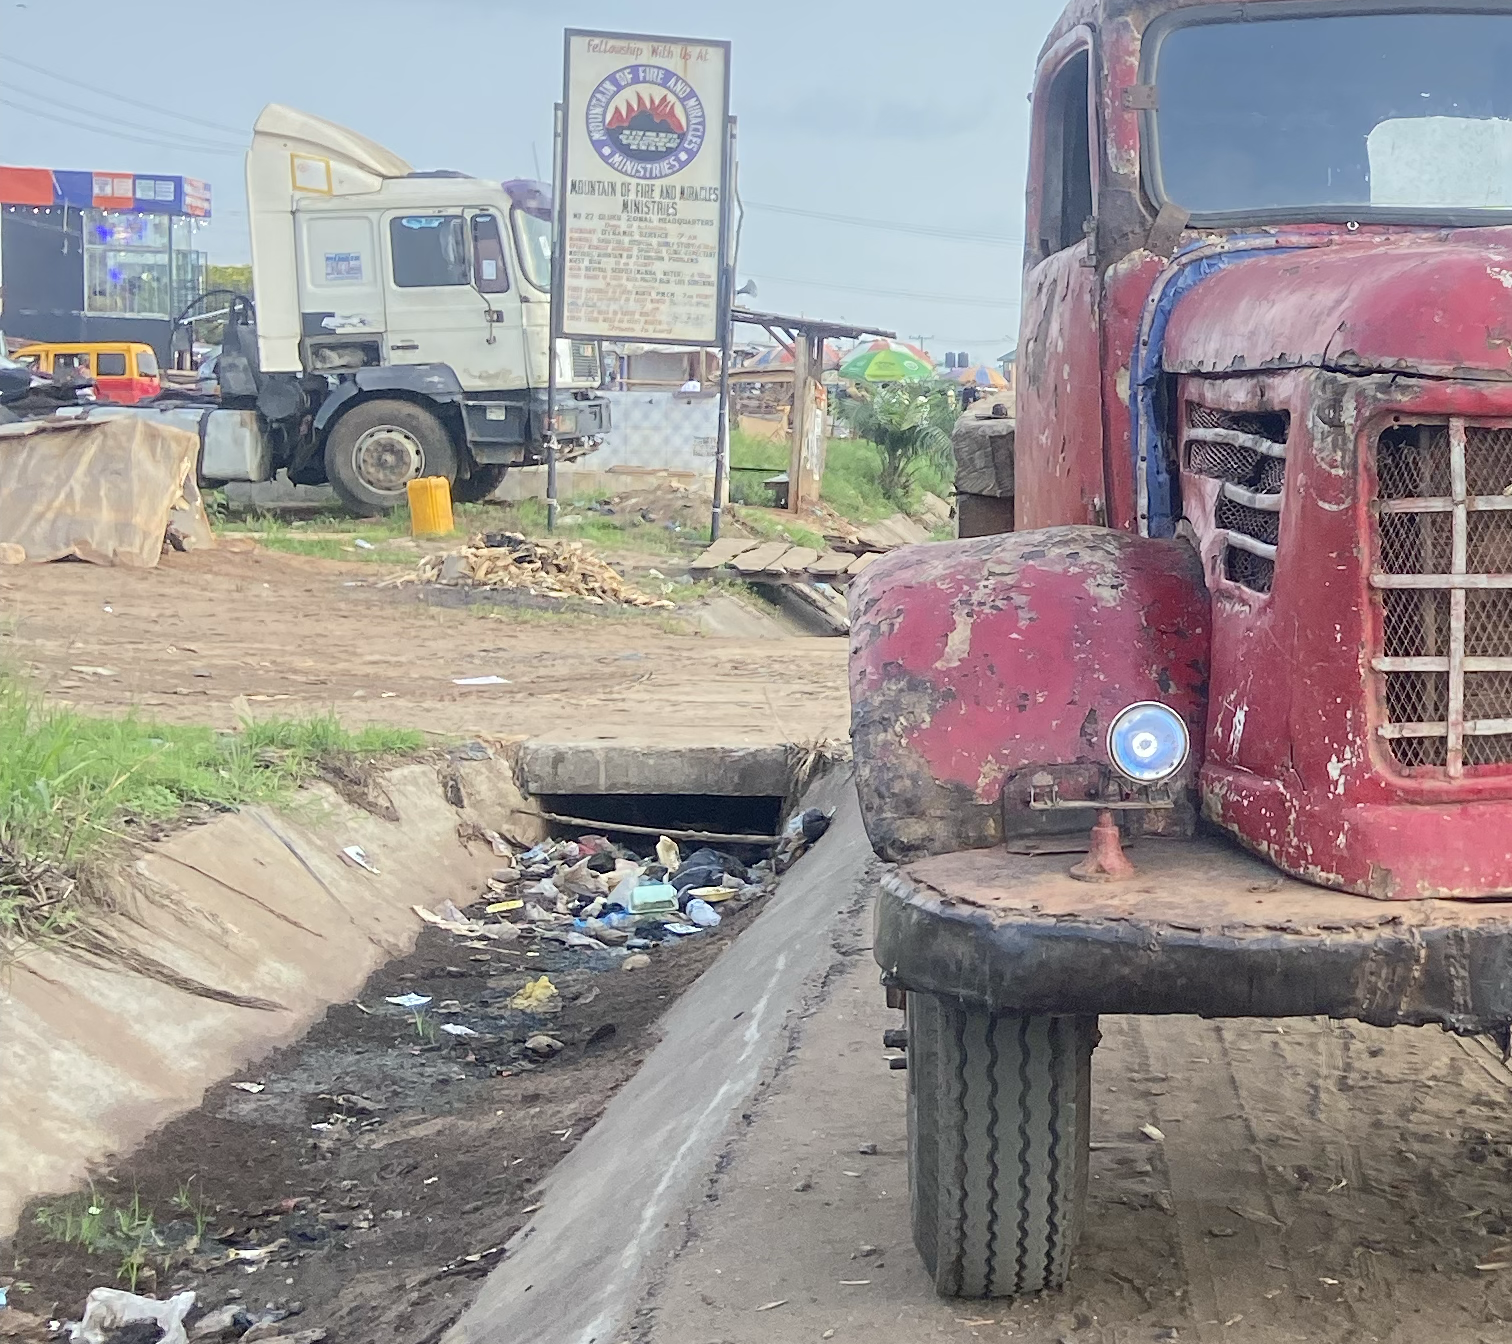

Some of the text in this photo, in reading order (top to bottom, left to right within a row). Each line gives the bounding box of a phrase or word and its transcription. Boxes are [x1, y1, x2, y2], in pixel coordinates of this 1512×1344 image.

[586, 38, 643, 60] Fellowship
[651, 44, 673, 59] With
[588, 67, 704, 151] MOUNTAIN OF FIRE AND MIRACLES
[608, 153, 680, 178] MINISTRIES
[570, 179, 719, 203] MOUNTAIN OF FIRE AND MIRACLES
[621, 199, 678, 216] MINISTRIES
[626, 215, 654, 224] ZONAL
[658, 217, 714, 227] HEADQUARTERS
